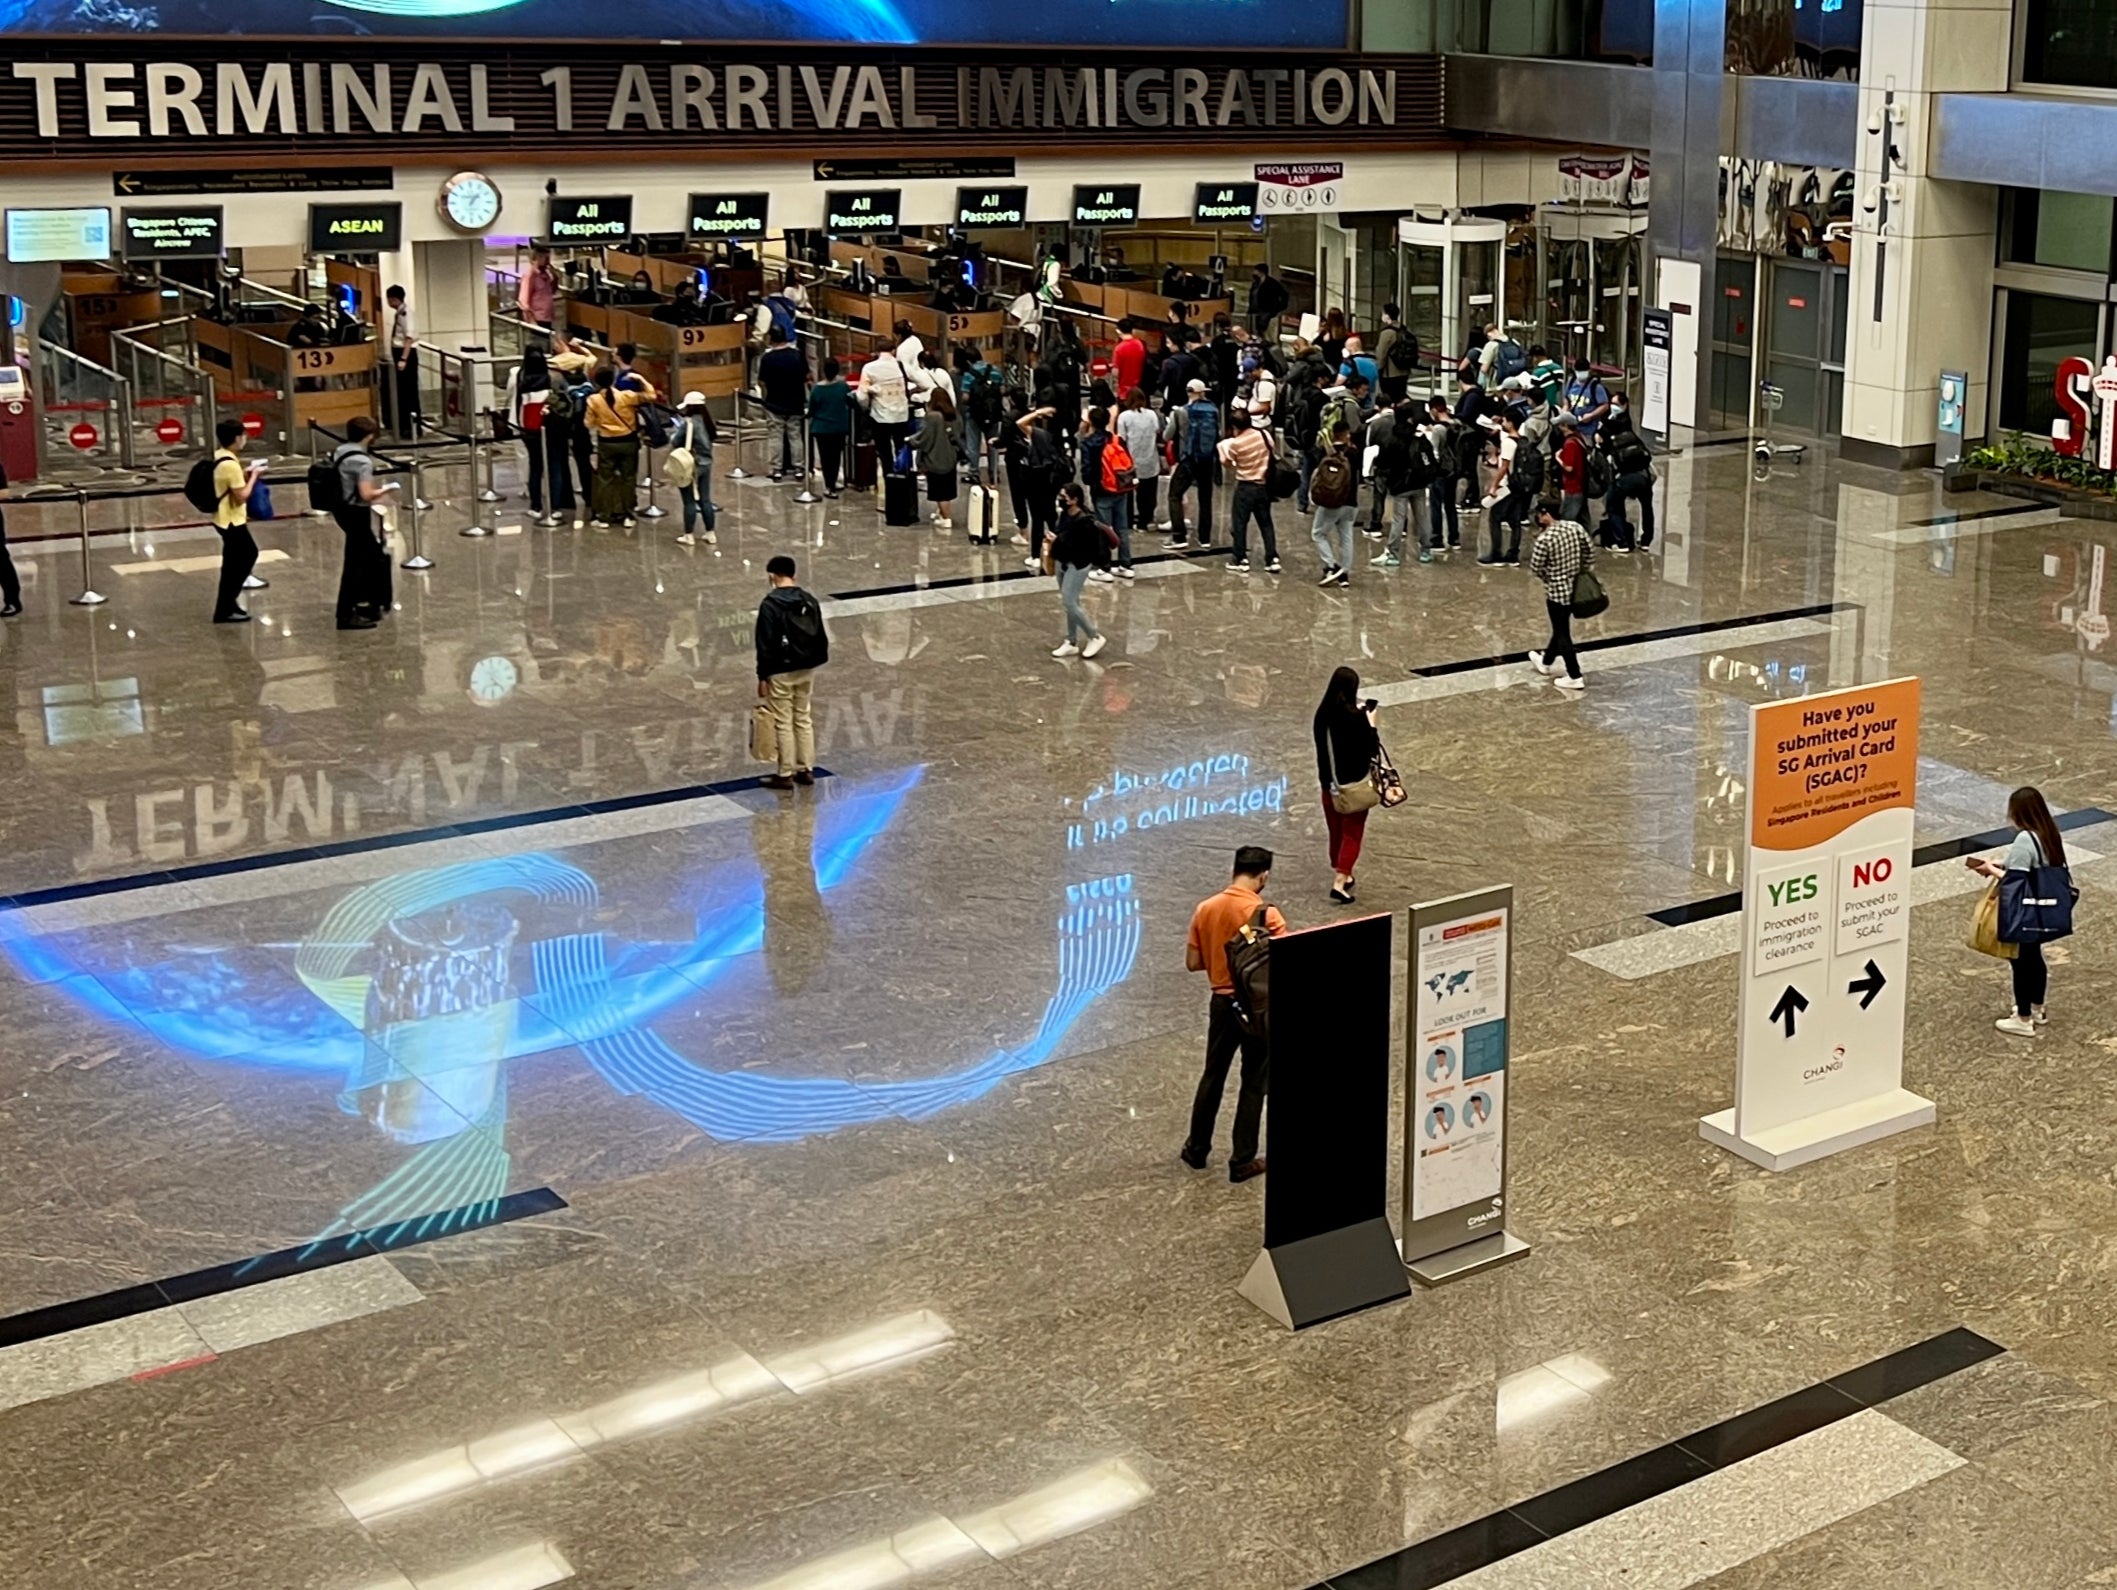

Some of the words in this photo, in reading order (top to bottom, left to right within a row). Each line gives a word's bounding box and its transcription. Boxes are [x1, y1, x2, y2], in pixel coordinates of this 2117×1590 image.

[12, 62, 515, 137] TERMINAL
[540, 66, 572, 131] 1
[606, 64, 938, 132] ARRIVAL
[957, 66, 1397, 129] IMMIGRATION
[1257, 166, 1290, 176] SPECIAL
[1291, 165, 1341, 175] ASSISTANCE
[851, 197, 871, 211] All
[981, 194, 999, 207] All
[1096, 191, 1114, 205] All
[1217, 189, 1234, 202] All
[577, 203, 598, 218] All
[716, 201, 737, 215] All
[960, 209, 1020, 224] Passports
[1077, 206, 1133, 221] Passports
[1199, 203, 1251, 218] Passports
[329, 219, 384, 235] ASEAN
[553, 221, 625, 236] Passports
[693, 216, 761, 233] Passports
[830, 213, 894, 228] Passports
[950, 315, 959, 331] 5
[683, 329, 694, 346] 9
[297, 351, 322, 369] 13
[1803, 708, 1842, 727] Have
[1846, 702, 1875, 722] you
[1777, 722, 1859, 754] submitted
[1862, 718, 1898, 740] your
[1778, 757, 1800, 775] SG
[1803, 744, 1856, 770] Arrival
[1859, 736, 1895, 757] Card
[1806, 763, 1868, 794] (SGAC)?
[1767, 812, 1809, 827] Singapore
[1811, 802, 1849, 817] Residents
[1851, 798, 1867, 808] and
[1868, 791, 1902, 804] Children
[1853, 858, 1892, 888] NO
[1767, 874, 1818, 907] YES
[1845, 893, 1886, 912] Proceed
[1887, 892, 1898, 902] to
[1763, 912, 1806, 932] Proceed
[1808, 911, 1819, 921] to
[1840, 909, 1876, 928] submit
[1877, 905, 1900, 921] your
[1759, 925, 1823, 948] immigration
[1856, 922, 1885, 939] SGAC
[1765, 940, 1815, 961] clearance
[1803, 1060, 1844, 1080] CHANGI
